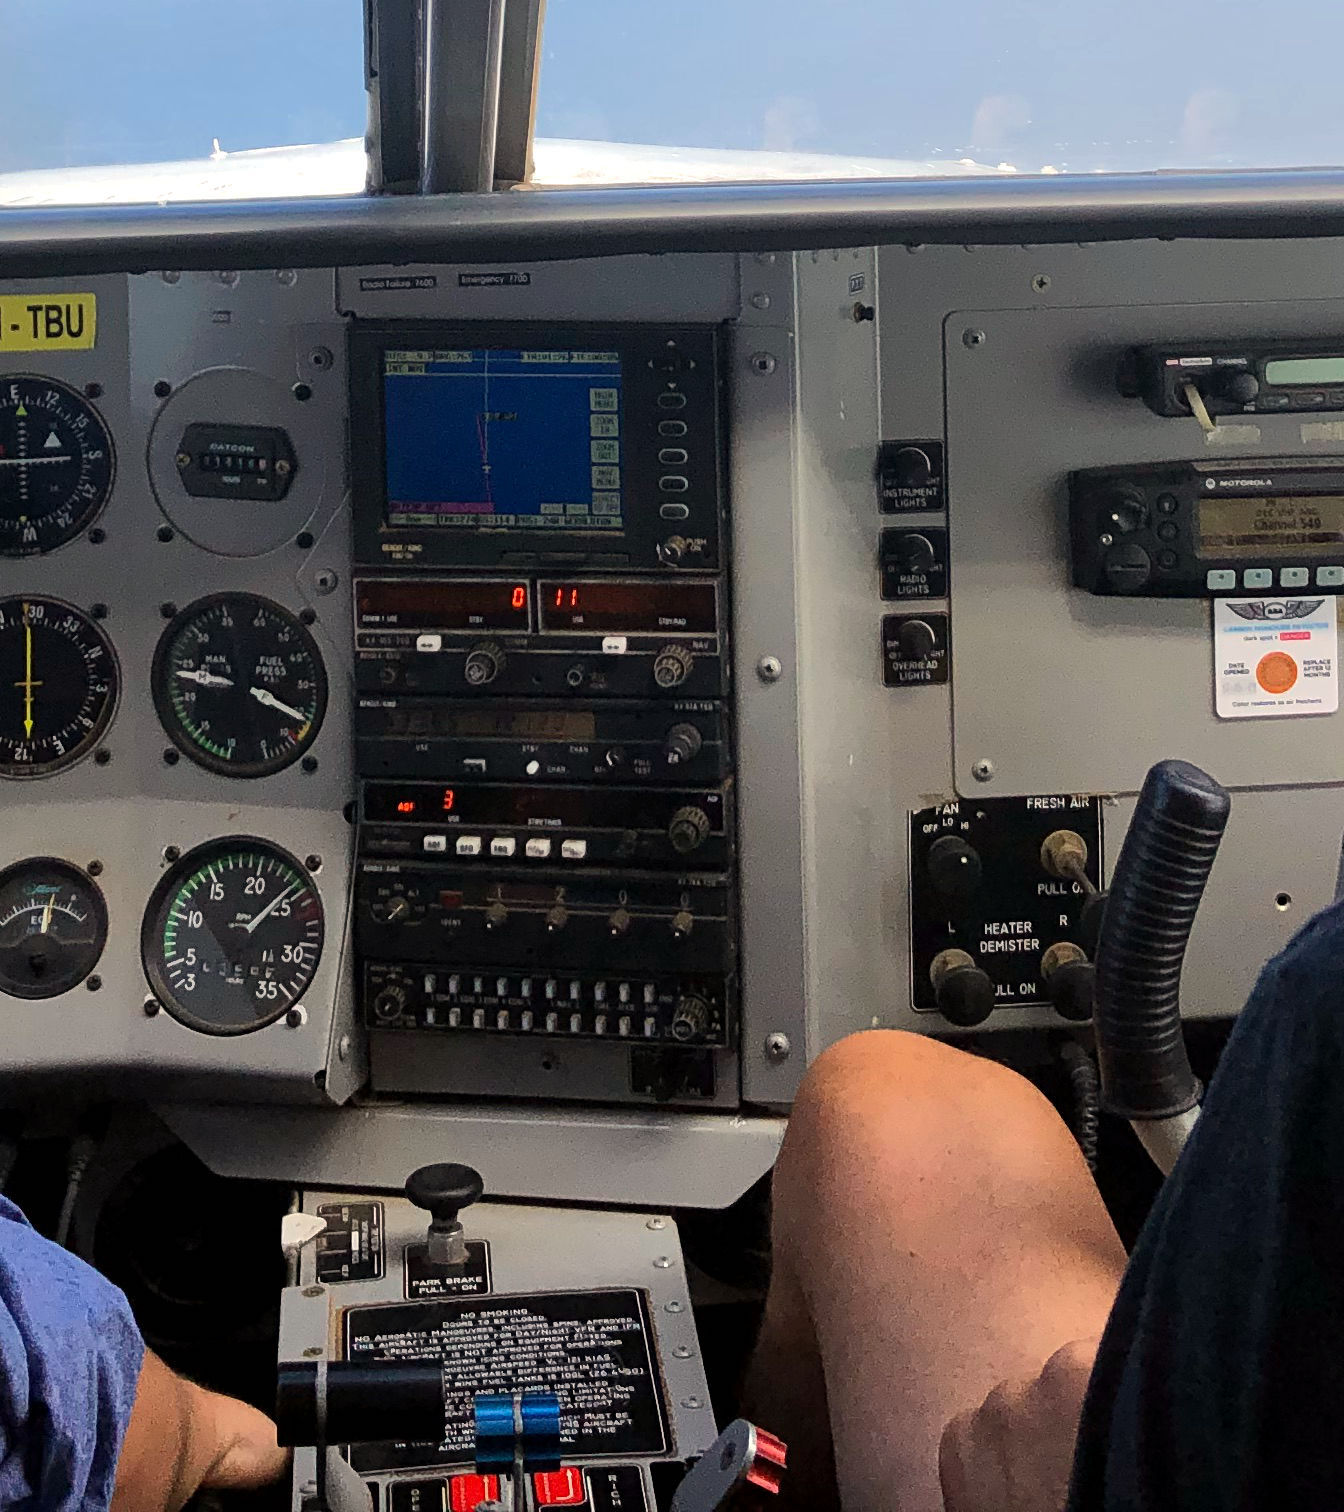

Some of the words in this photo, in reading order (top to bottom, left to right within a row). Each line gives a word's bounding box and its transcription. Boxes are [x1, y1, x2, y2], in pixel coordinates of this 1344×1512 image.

[27, 304, 84, 339] TBU
[10, 384, 20, 399] E
[45, 391, 60, 407] 12
[1220, 479, 1273, 487] MOTOROLA
[883, 488, 938, 498] INSTRUMENT
[894, 497, 927, 508] LIGHTS
[1255, 518, 1297, 530] Channel
[900, 574, 927, 584] RADIO
[897, 583, 930, 594] LIGHTS
[512, 587, 525, 608] 0
[556, 588, 577, 606] 11
[29, 605, 44, 618] 30
[63, 616, 80, 632] 33
[692, 640, 709, 649] NAV
[87, 645, 104, 659] N
[206, 654, 226, 663] MAN
[259, 656, 283, 665] FUEL
[256, 666, 286, 676] PRESS
[892, 660, 939, 671] OVERHEAD
[899, 670, 931, 681] LIGHTS
[96, 684, 107, 693] 3
[297, 680, 309, 689] 30
[184, 692, 196, 702] 20
[280, 728, 288, 736] 10
[227, 738, 236, 747] 10
[14, 748, 29, 761] 12
[443, 790, 454, 809] 3
[1027, 797, 1066, 809] FRESH
[1070, 795, 1090, 808] AIR
[935, 803, 960, 815] FAN
[942, 817, 954, 827] LO
[960, 821, 969, 830] HI
[923, 824, 938, 833] OFF
[244, 876, 266, 895] 20
[1038, 883, 1067, 895] PULL
[1072, 882, 1084, 894] O
[210, 883, 224, 901] 15
[188, 911, 203, 928] 10
[1060, 914, 1068, 927] R
[948, 921, 955, 933] L
[984, 921, 1032, 935] HEATER
[980, 939, 1040, 953] DEMISTER
[186, 948, 196, 965] 5
[281, 945, 304, 963] 30
[185, 973, 196, 991] 3
[256, 980, 278, 1000] 35
[993, 984, 1014, 996] ULL
[1019, 983, 1036, 995] ON
[412, 1278, 441, 1287] PARK
[446, 1276, 483, 1285] BRAKE
[419, 1285, 446, 1294] PULL
[462, 1283, 477, 1291] ON
[460, 1311, 475, 1319] NO
[480, 1308, 527, 1318] SMOKING
[378, 1339, 425, 1349] AIRCRAFT
[442, 1334, 490, 1344] APPROVED
[464, 1348, 486, 1357] NOT
[584, 1353, 611, 1362] KIAS
[475, 1388, 495, 1396] AND
[584, 1412, 611, 1420] MUST
[597, 1426, 616, 1434] THE
[438, 1443, 476, 1451] AIRCRA
[608, 1473, 622, 1506] RICH
